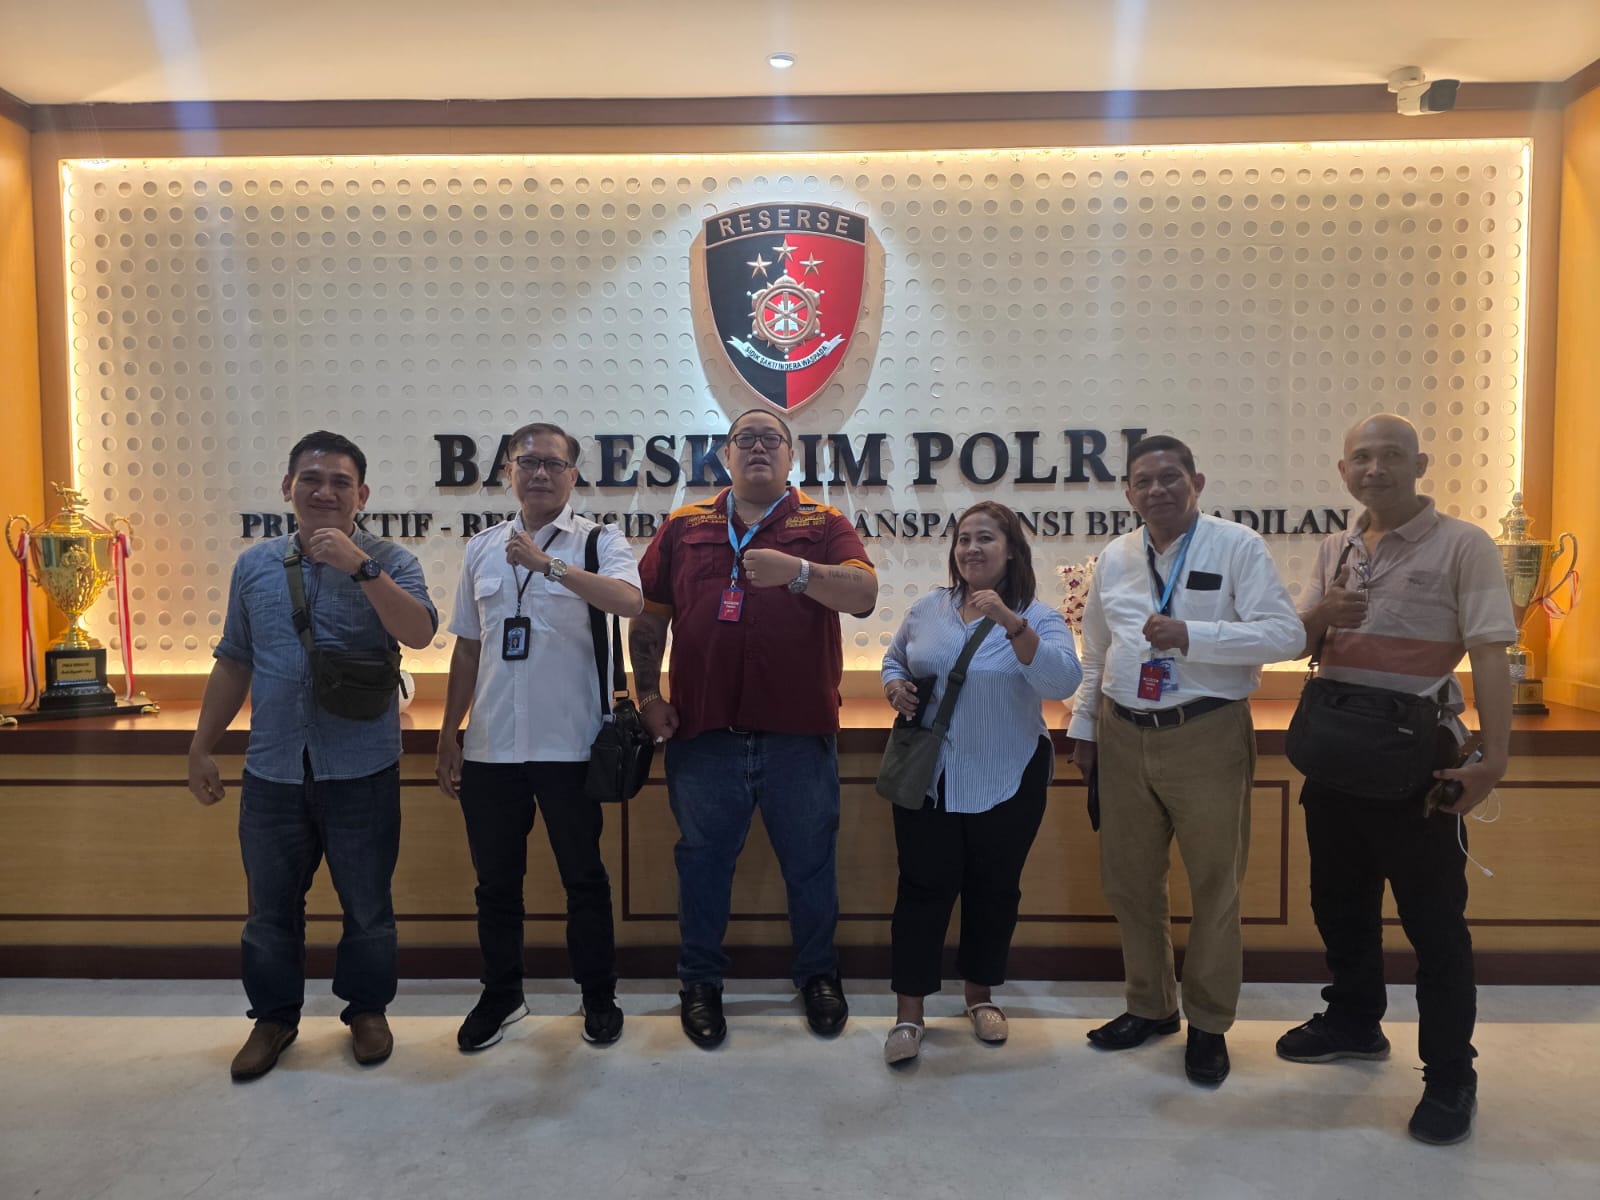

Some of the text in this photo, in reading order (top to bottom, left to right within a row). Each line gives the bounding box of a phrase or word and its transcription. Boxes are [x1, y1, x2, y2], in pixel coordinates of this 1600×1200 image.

[718, 209, 850, 237] RESERSE
[745, 345, 827, 370] SIDIK SAKTI INDERA WASPADA
